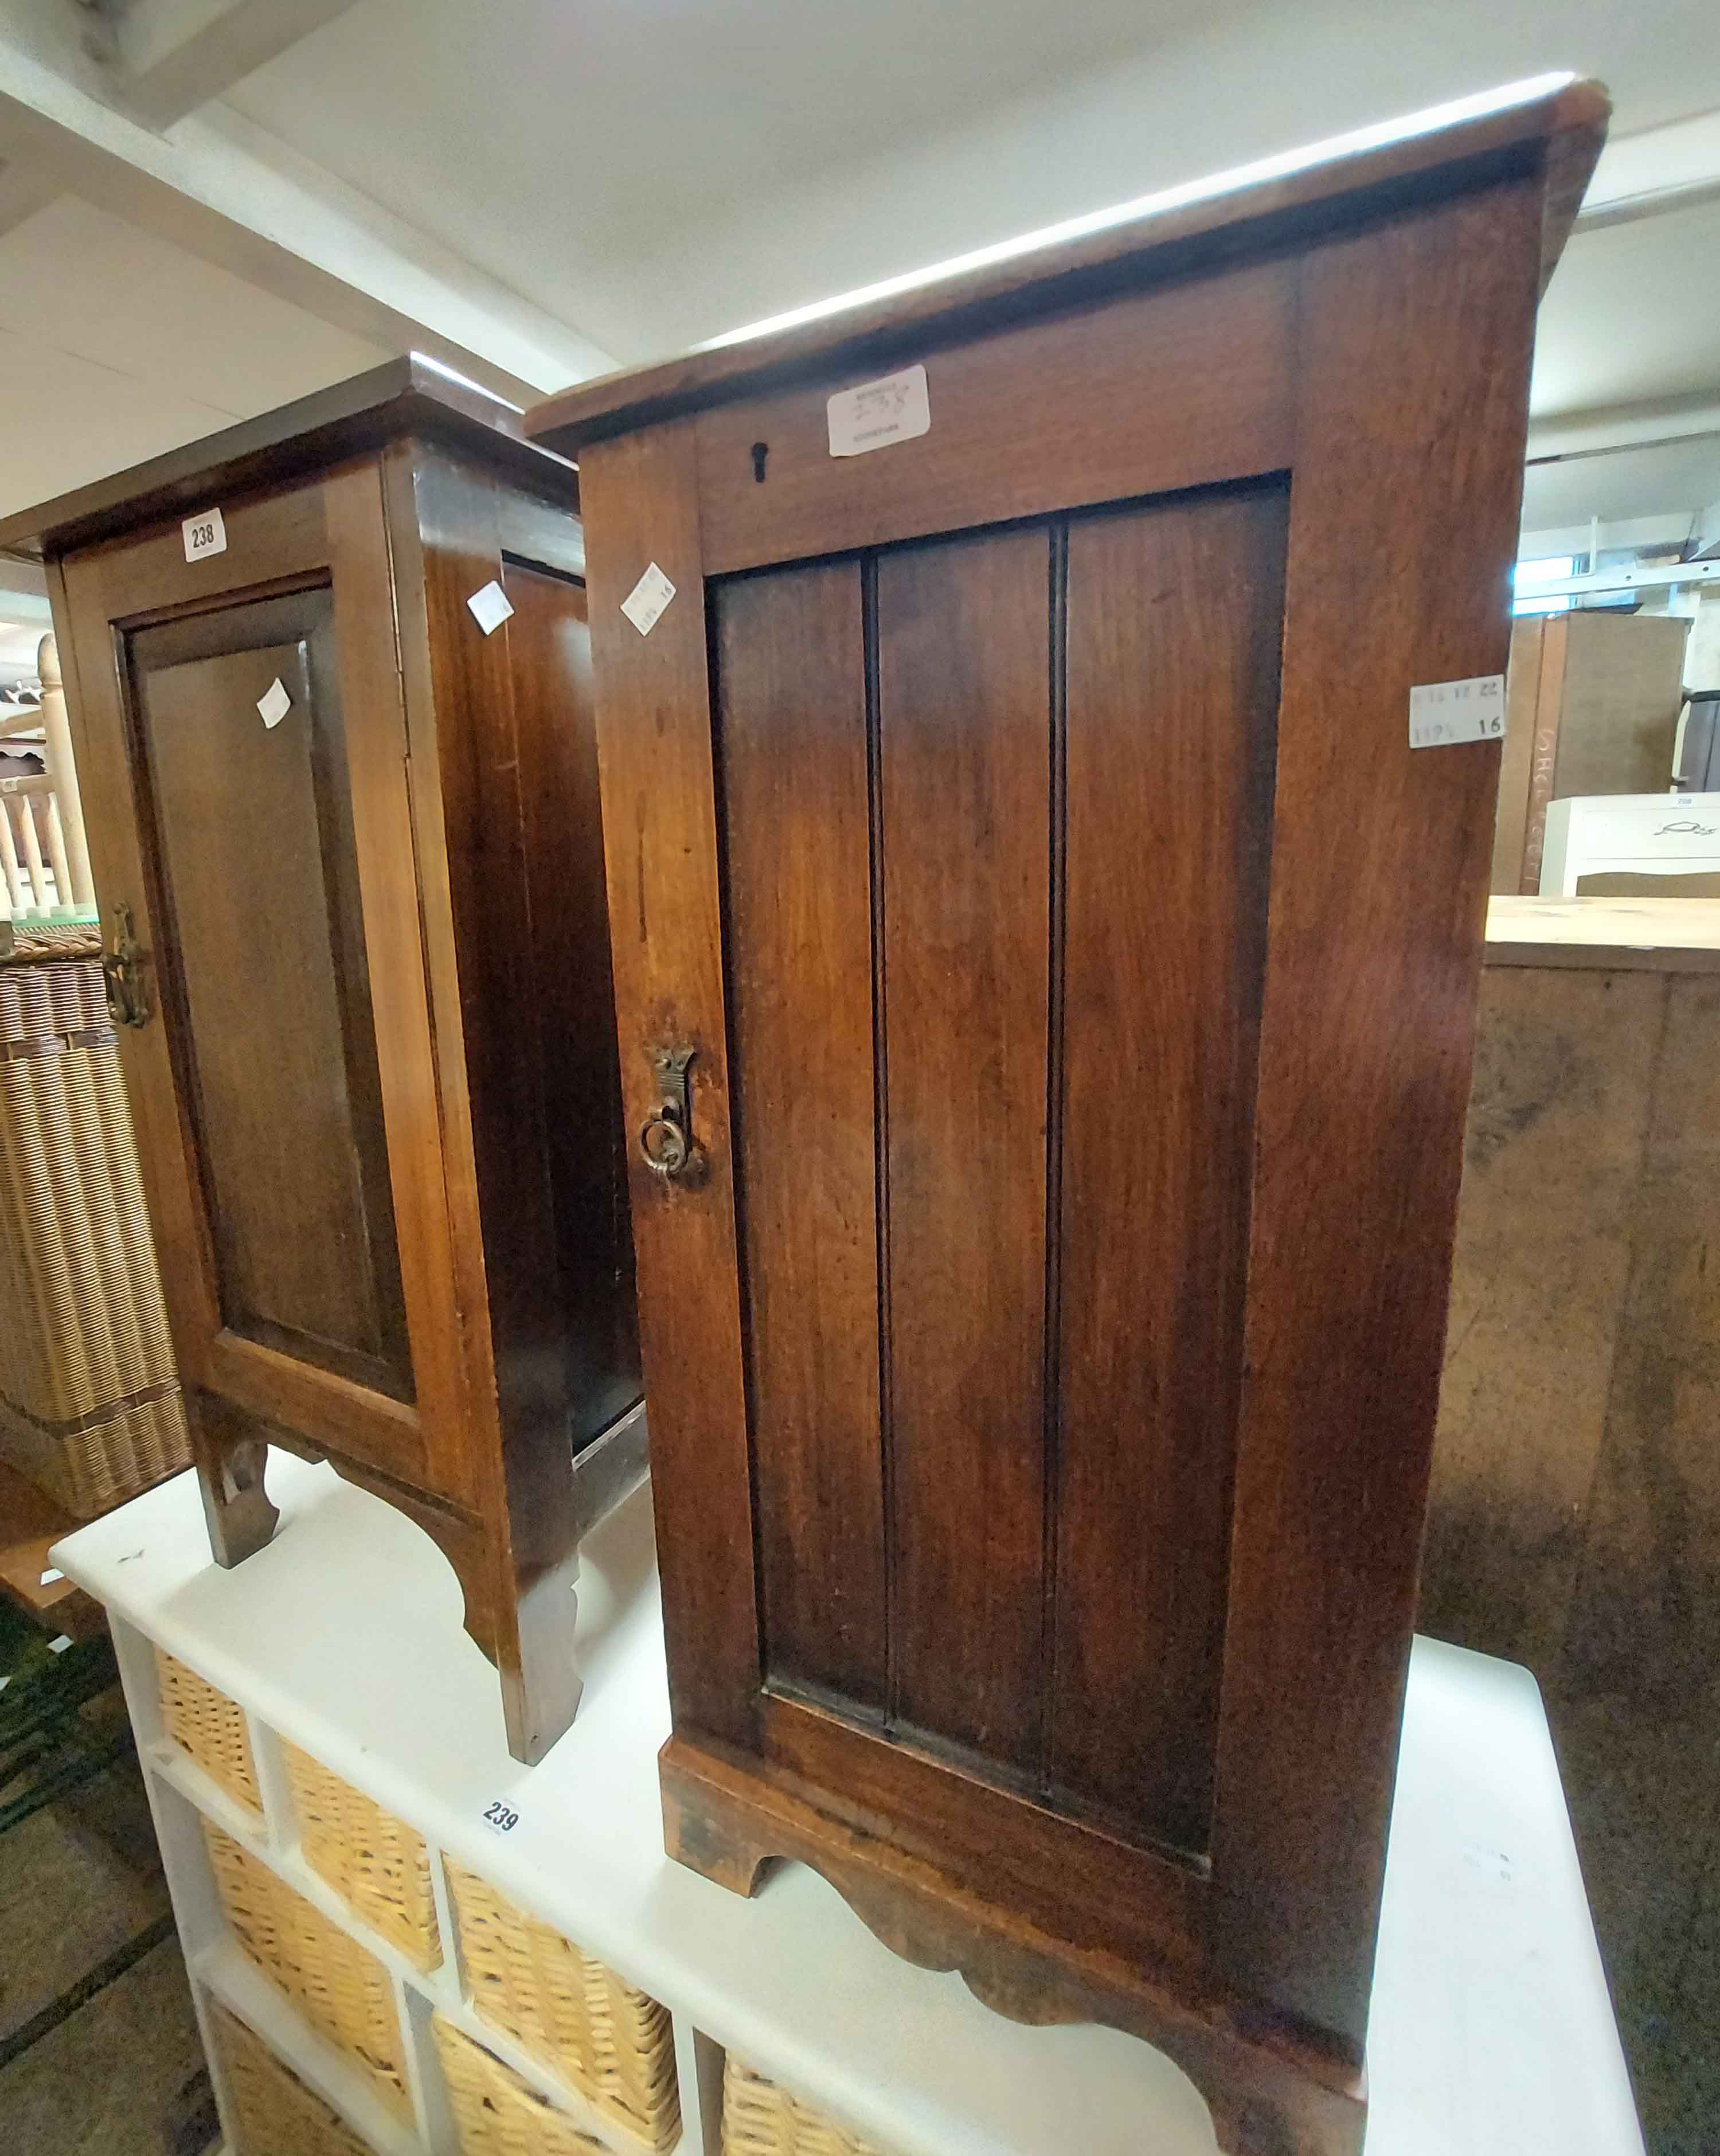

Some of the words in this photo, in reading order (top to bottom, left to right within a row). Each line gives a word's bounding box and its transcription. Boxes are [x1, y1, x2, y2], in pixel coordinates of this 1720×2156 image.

[191, 524, 214, 548] 238
[1479, 716, 1501, 735] 16
[482, 1801, 519, 1831] 239
